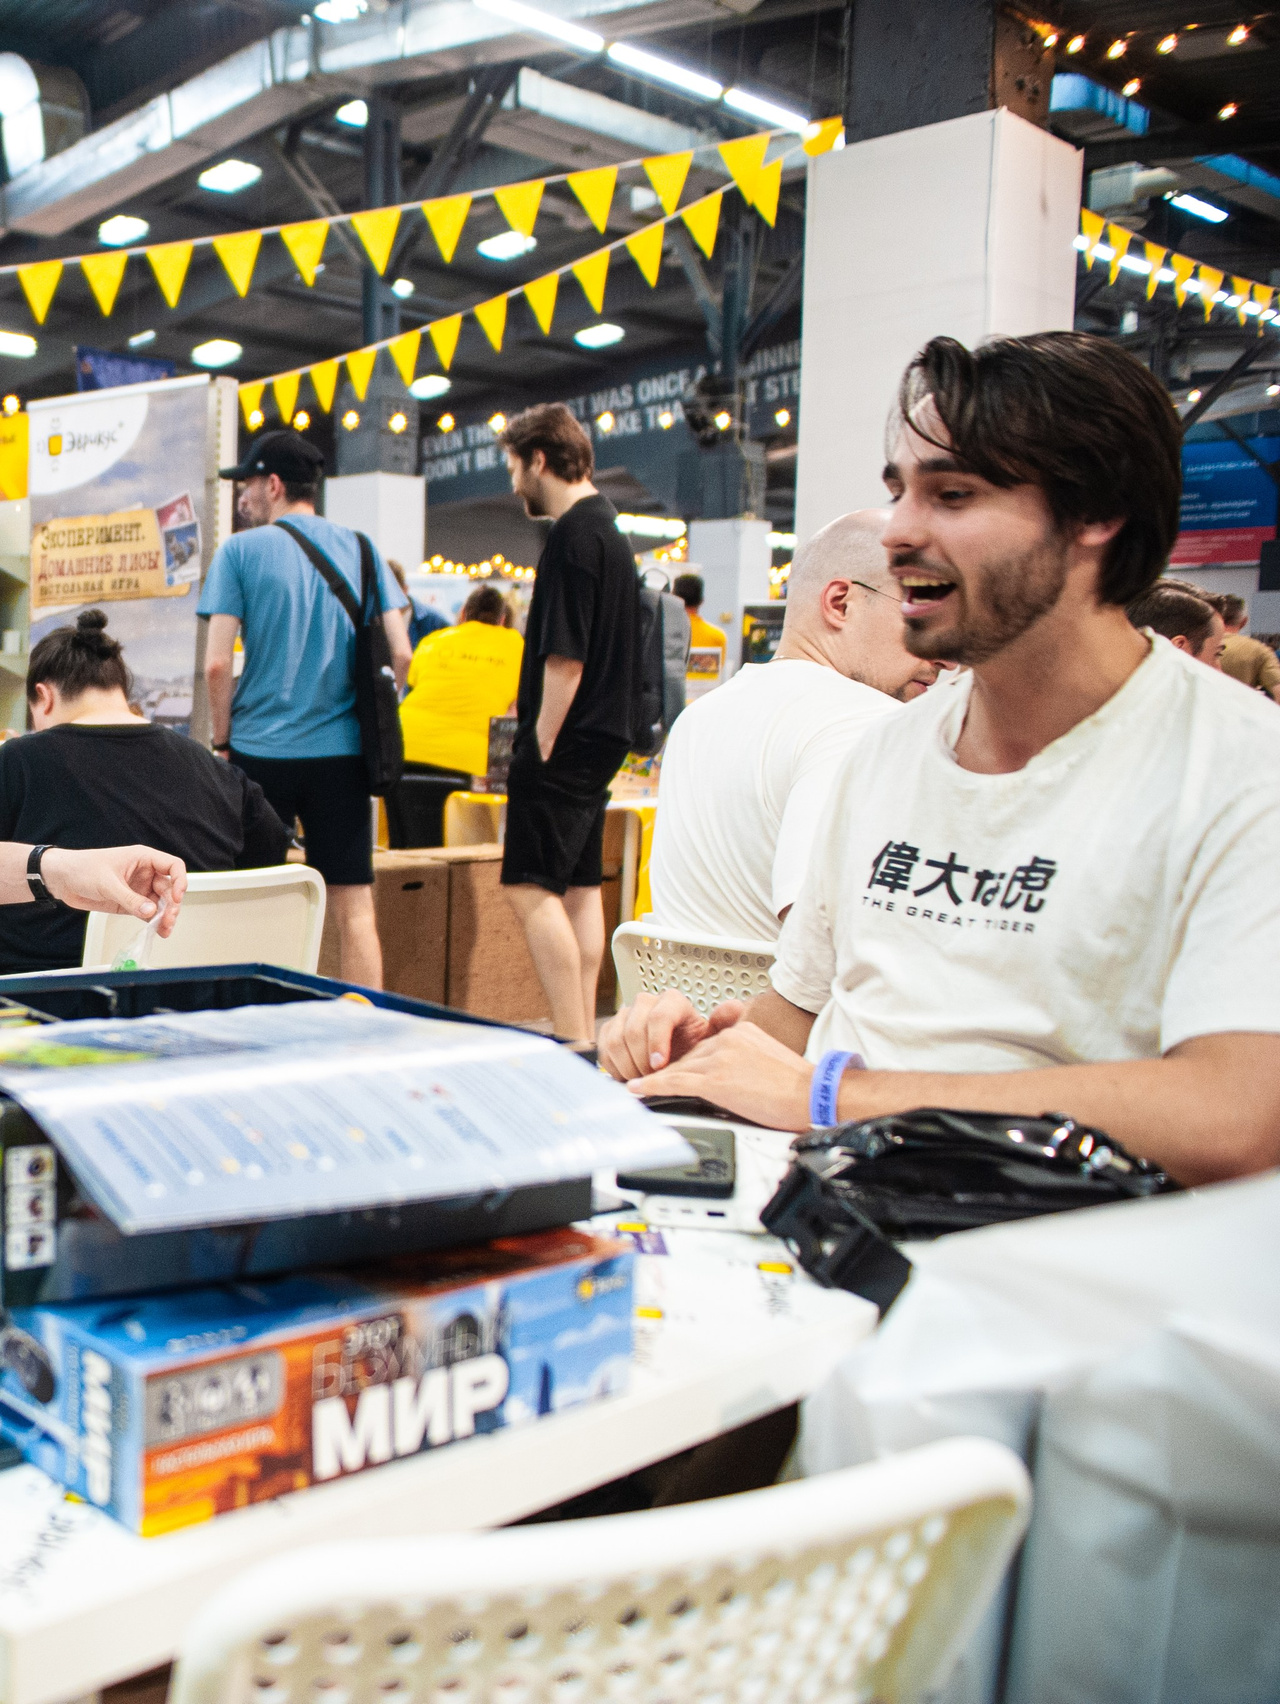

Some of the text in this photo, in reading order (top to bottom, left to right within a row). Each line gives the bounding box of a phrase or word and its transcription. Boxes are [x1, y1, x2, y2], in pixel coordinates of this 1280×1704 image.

[590, 383, 634, 415] WAS
[867, 840, 1058, 913] 偉大な虎
[861, 896, 1036, 934] THE GREAT TIGER
[310, 1352, 511, 1480] МИР
